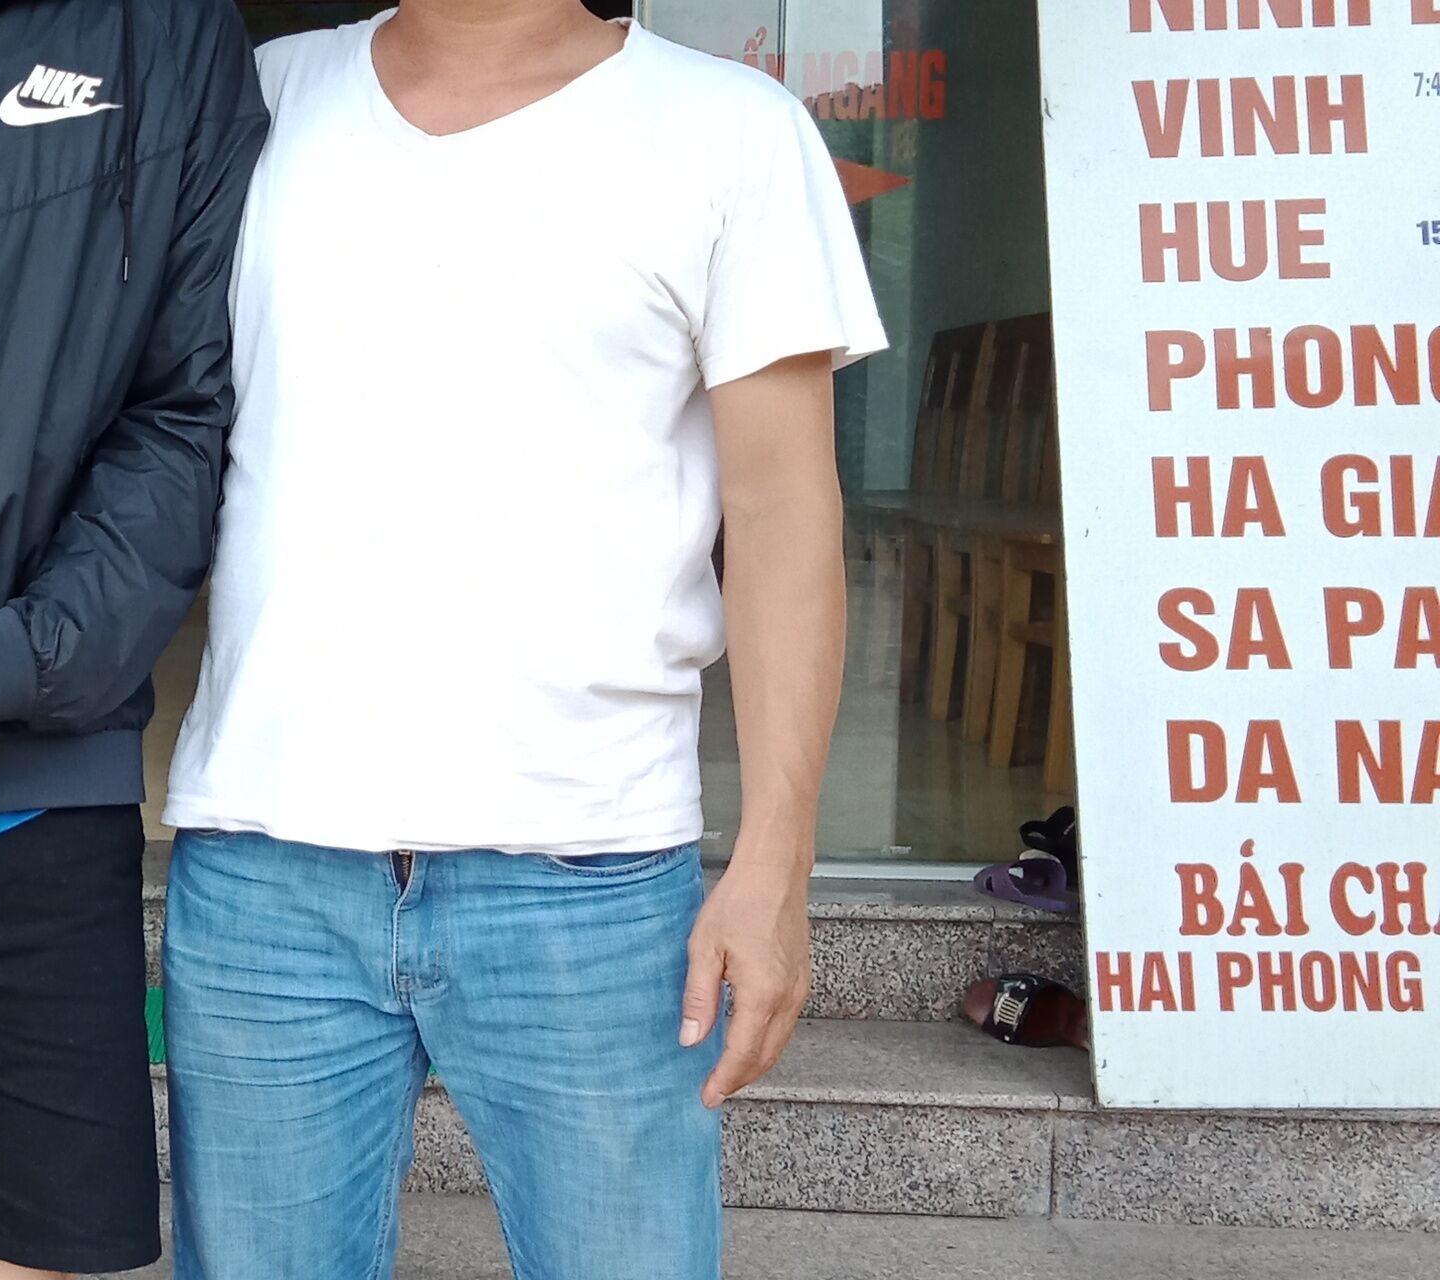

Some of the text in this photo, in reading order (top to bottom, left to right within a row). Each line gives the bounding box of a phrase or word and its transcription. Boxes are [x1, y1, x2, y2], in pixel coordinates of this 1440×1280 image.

[19, 64, 103, 108] NIKE
[802, 49, 947, 120] NGANG
[1131, 73, 1368, 158] VINH
[1138, 197, 1331, 283] HUE
[1145, 323, 1440, 411] PHON
[1150, 455, 1287, 538] HA
[1157, 586, 1292, 673] SA
[1166, 719, 1301, 804] DA
[1095, 949, 1425, 1013] HAI PHONG
